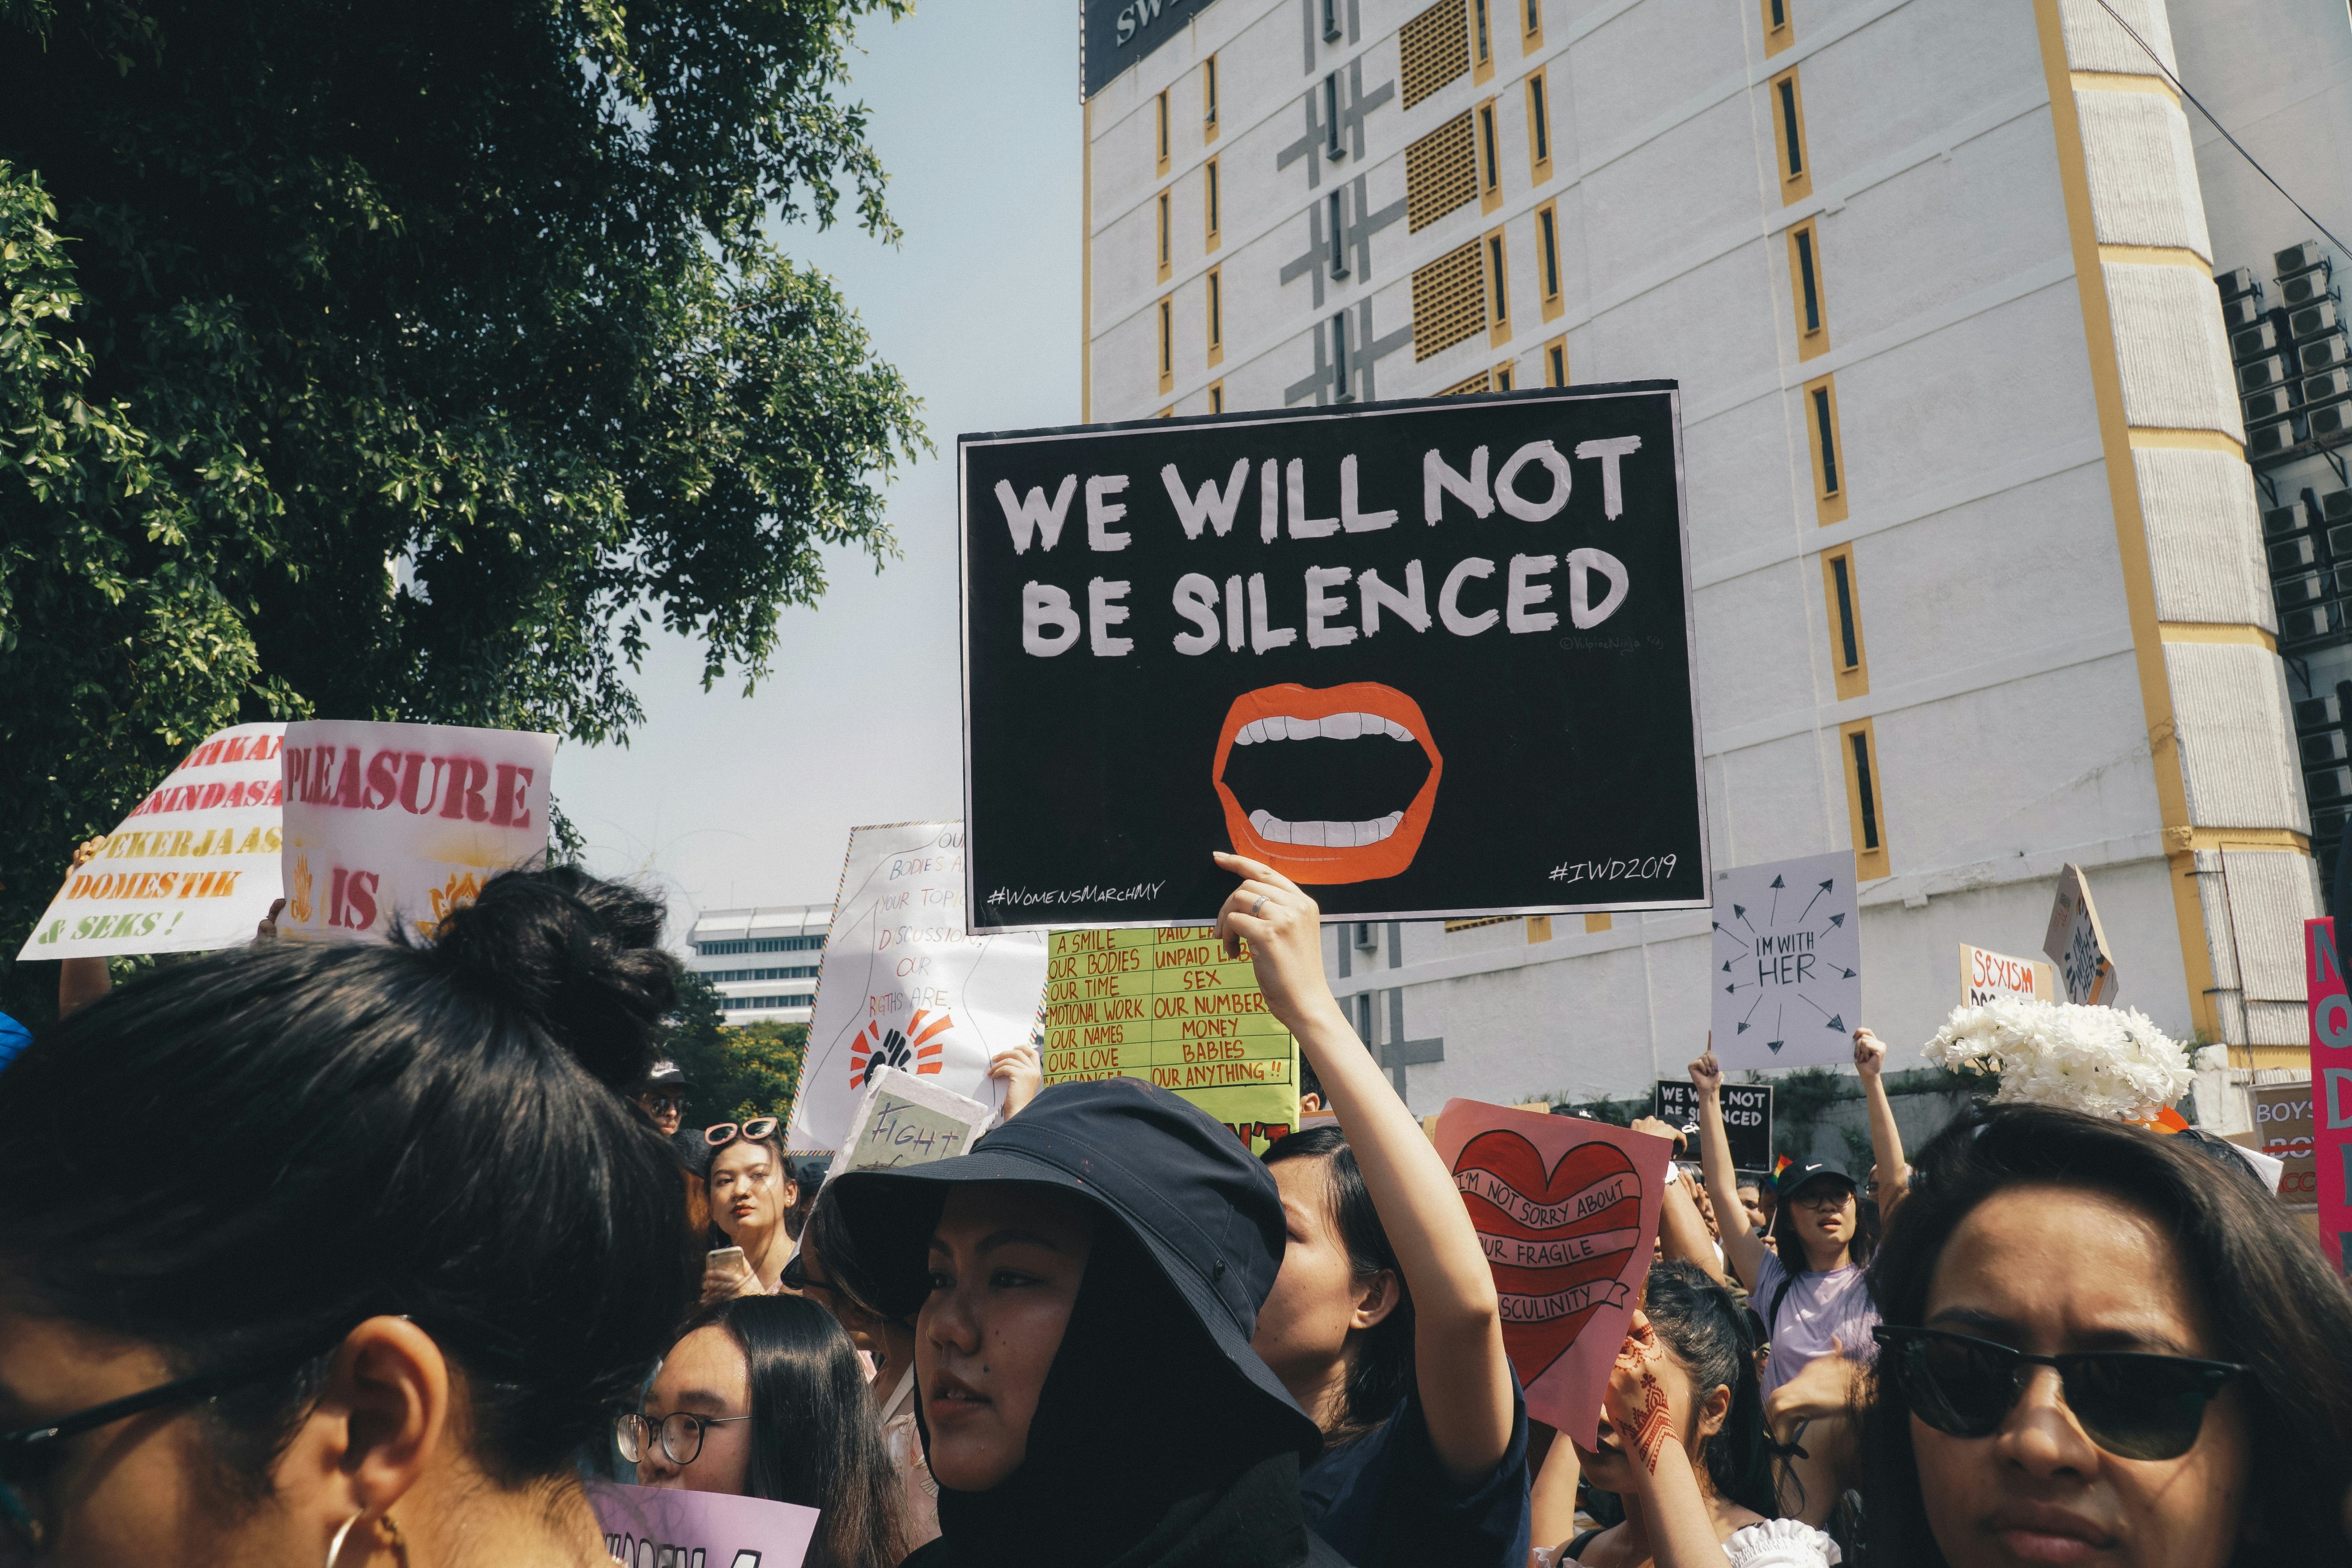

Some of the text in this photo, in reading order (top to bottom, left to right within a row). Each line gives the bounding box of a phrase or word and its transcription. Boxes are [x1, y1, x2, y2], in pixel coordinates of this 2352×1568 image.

[994, 435, 1642, 556] WE WILL NOT
[1023, 548, 1629, 657] BE SILENCED
[286, 745, 534, 828] PLEASURE
[939, 833, 965, 849] OU
[889, 856, 944, 881] BODIES
[1548, 853, 1677, 884] #IWD2019
[328, 868, 379, 931] IS
[880, 892, 909, 914] YOUR
[38, 919, 66, 945] &
[71, 912, 164, 940] SEKS
[1057, 929, 1116, 954] A SMILE
[1756, 931, 1814, 957] I'M WITH
[897, 957, 931, 977] OUR
[1048, 948, 1140, 979] OUR BODIES
[1155, 946, 1210, 969] UNPAID
[1758, 953, 1816, 987] HER
[1051, 976, 1120, 1002] OUR TIME
[1183, 969, 1221, 990] SEX
[1104, 998, 1145, 1021] WORK
[1154, 992, 1272, 1019] OUR NUMBER
[1051, 1024, 1123, 1049] OUR NAMES
[1182, 1018, 1238, 1039] MONEY
[1048, 1047, 1119, 1072] OUR LOVE
[1182, 1039, 1245, 1063] BABIES
[1152, 1067, 1182, 1088] OUR
[1186, 1062, 1264, 1087] ANYTHING
[1662, 1086, 1683, 1102] WE
[1729, 1091, 1766, 1108] NOT
[871, 1101, 961, 1159] FIGHT
[1458, 1172, 1624, 1227] I'M NOT SORRY ABOUT
[1517, 1239, 1594, 1264] FRAGILE
[1499, 1285, 1590, 1319] SCULINITY
